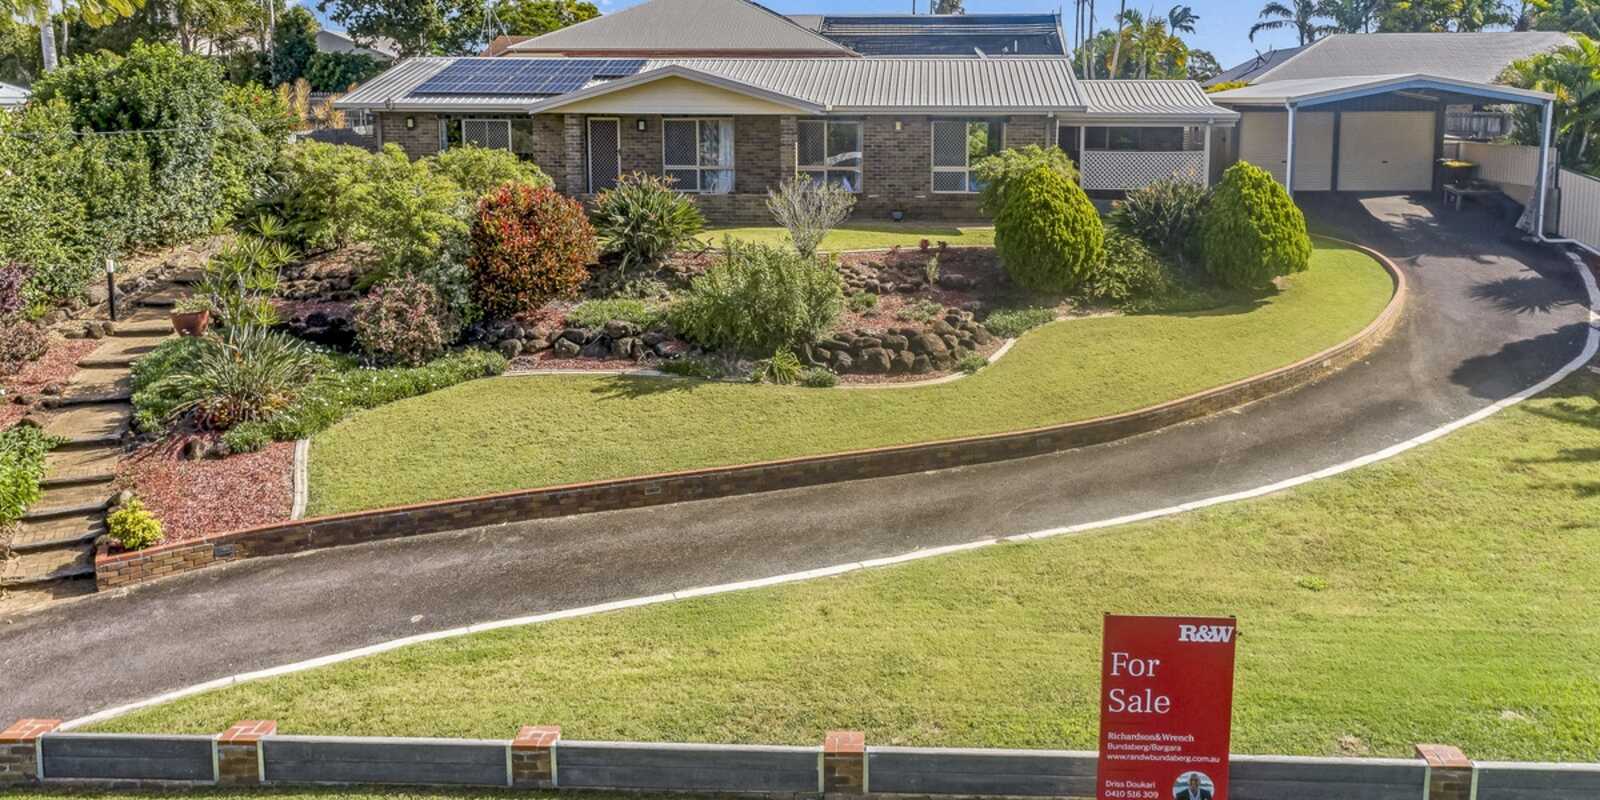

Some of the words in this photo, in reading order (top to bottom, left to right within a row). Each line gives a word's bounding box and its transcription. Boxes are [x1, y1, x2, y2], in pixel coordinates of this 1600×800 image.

[1178, 624, 1234, 643] R&W
[1110, 651, 1160, 677] For
[1108, 687, 1171, 714] Sale
[1107, 743, 1182, 752] Bundaberg/Bargara
[1106, 754, 1220, 763] www.randwbundaberg.com.au
[1106, 780, 1125, 788] Driss
[1105, 790, 1126, 798] 0410
[1127, 790, 1142, 798] 516
[1143, 791, 1159, 799] 309
